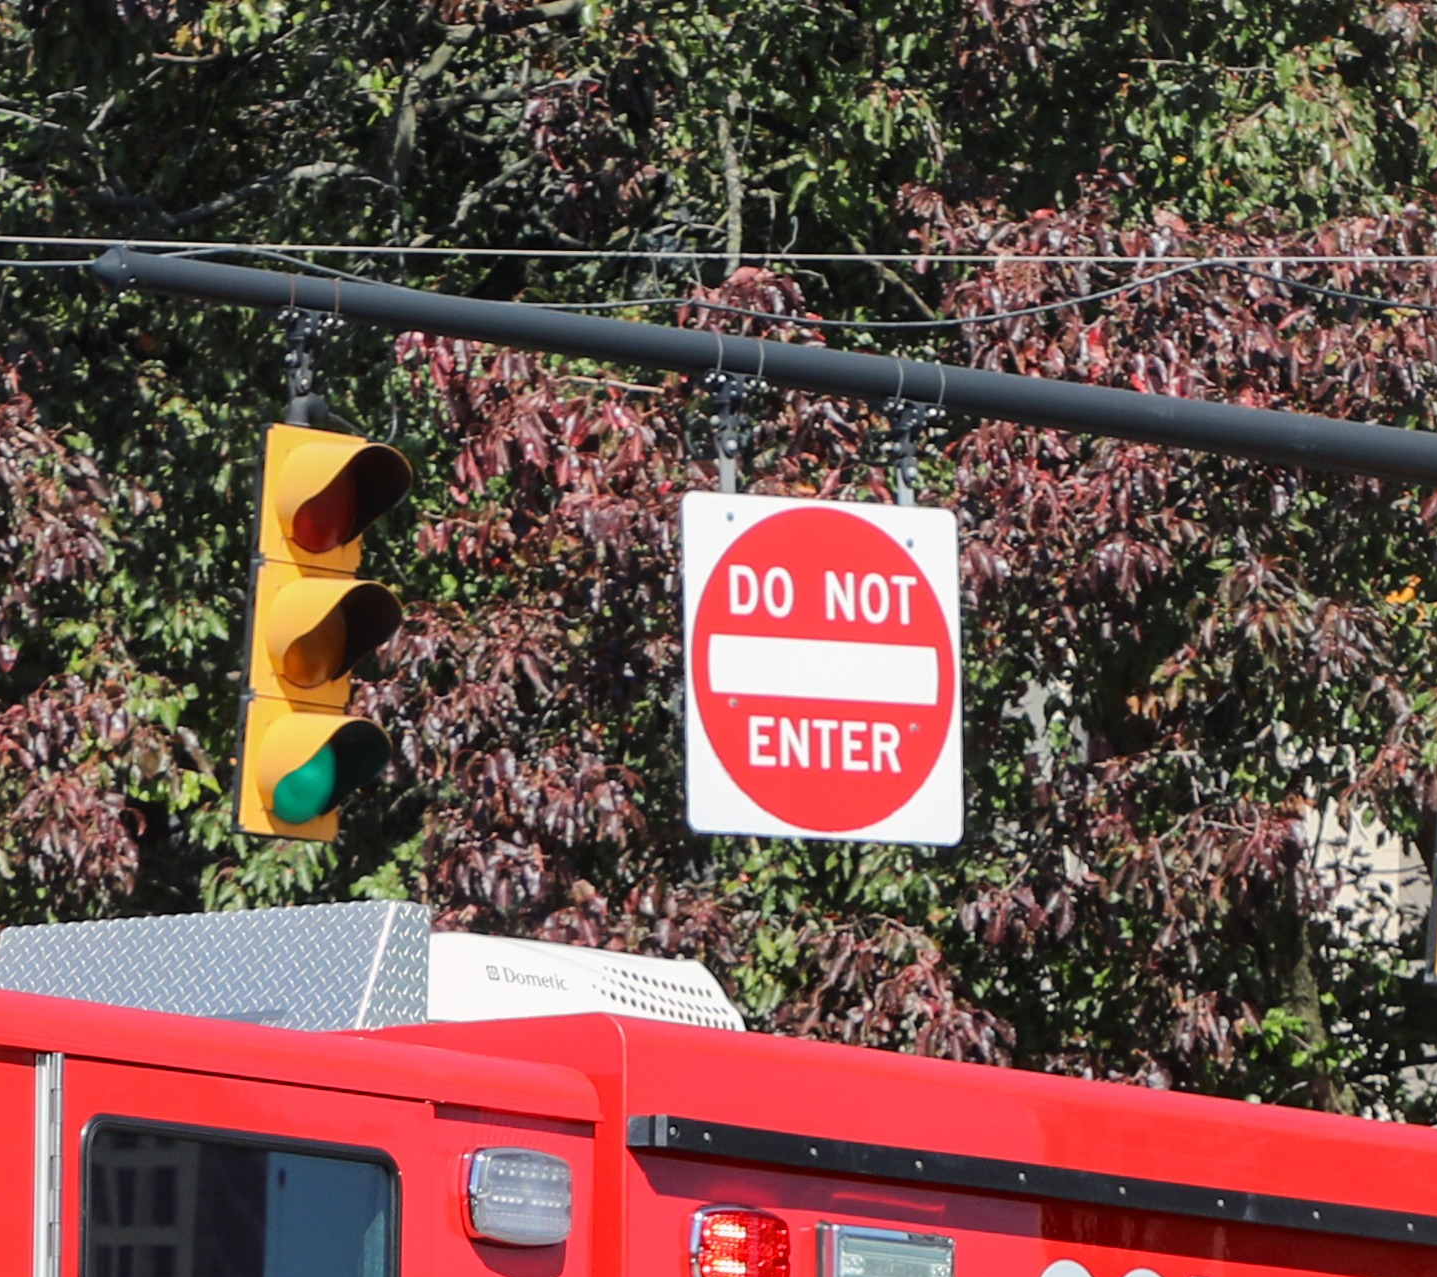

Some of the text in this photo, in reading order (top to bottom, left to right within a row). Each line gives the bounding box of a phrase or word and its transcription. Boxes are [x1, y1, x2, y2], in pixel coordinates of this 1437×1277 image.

[728, 564, 918, 626] DO NOT
[748, 715, 902, 774] ENTER
[503, 966, 568, 992] Dometic
